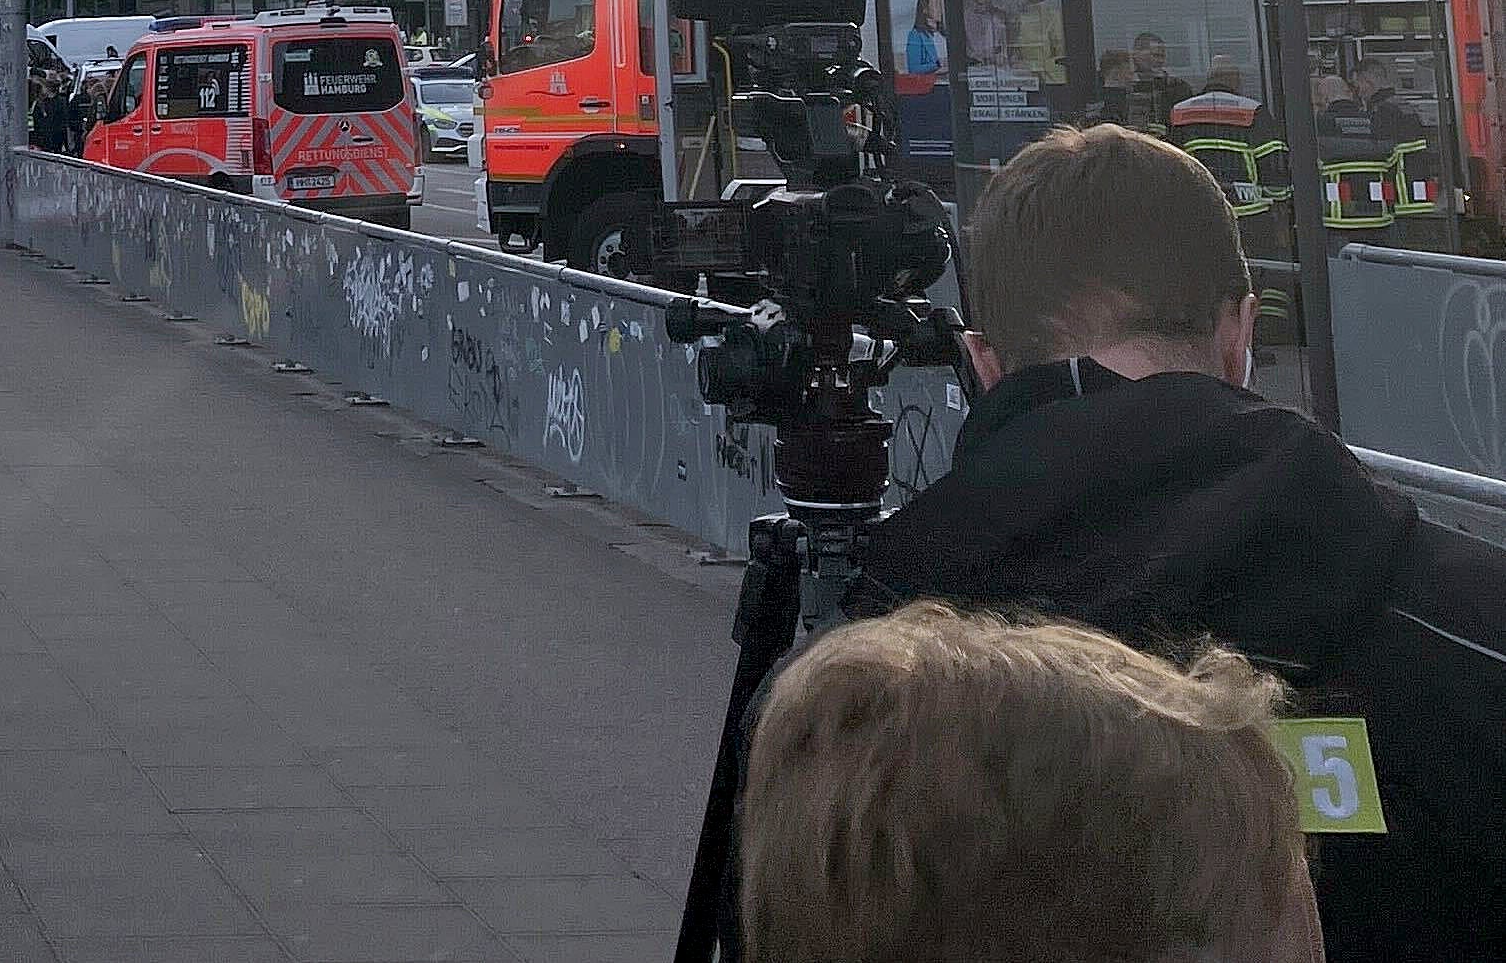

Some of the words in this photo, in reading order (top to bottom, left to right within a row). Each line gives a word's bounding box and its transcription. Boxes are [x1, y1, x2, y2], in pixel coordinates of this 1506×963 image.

[319, 74, 377, 85] FEUERWEHR
[319, 84, 367, 95] HAMBURG
[199, 87, 216, 108] 112
[298, 147, 390, 162] RETTUNGSDIENST
[1301, 735, 1359, 820] 5
